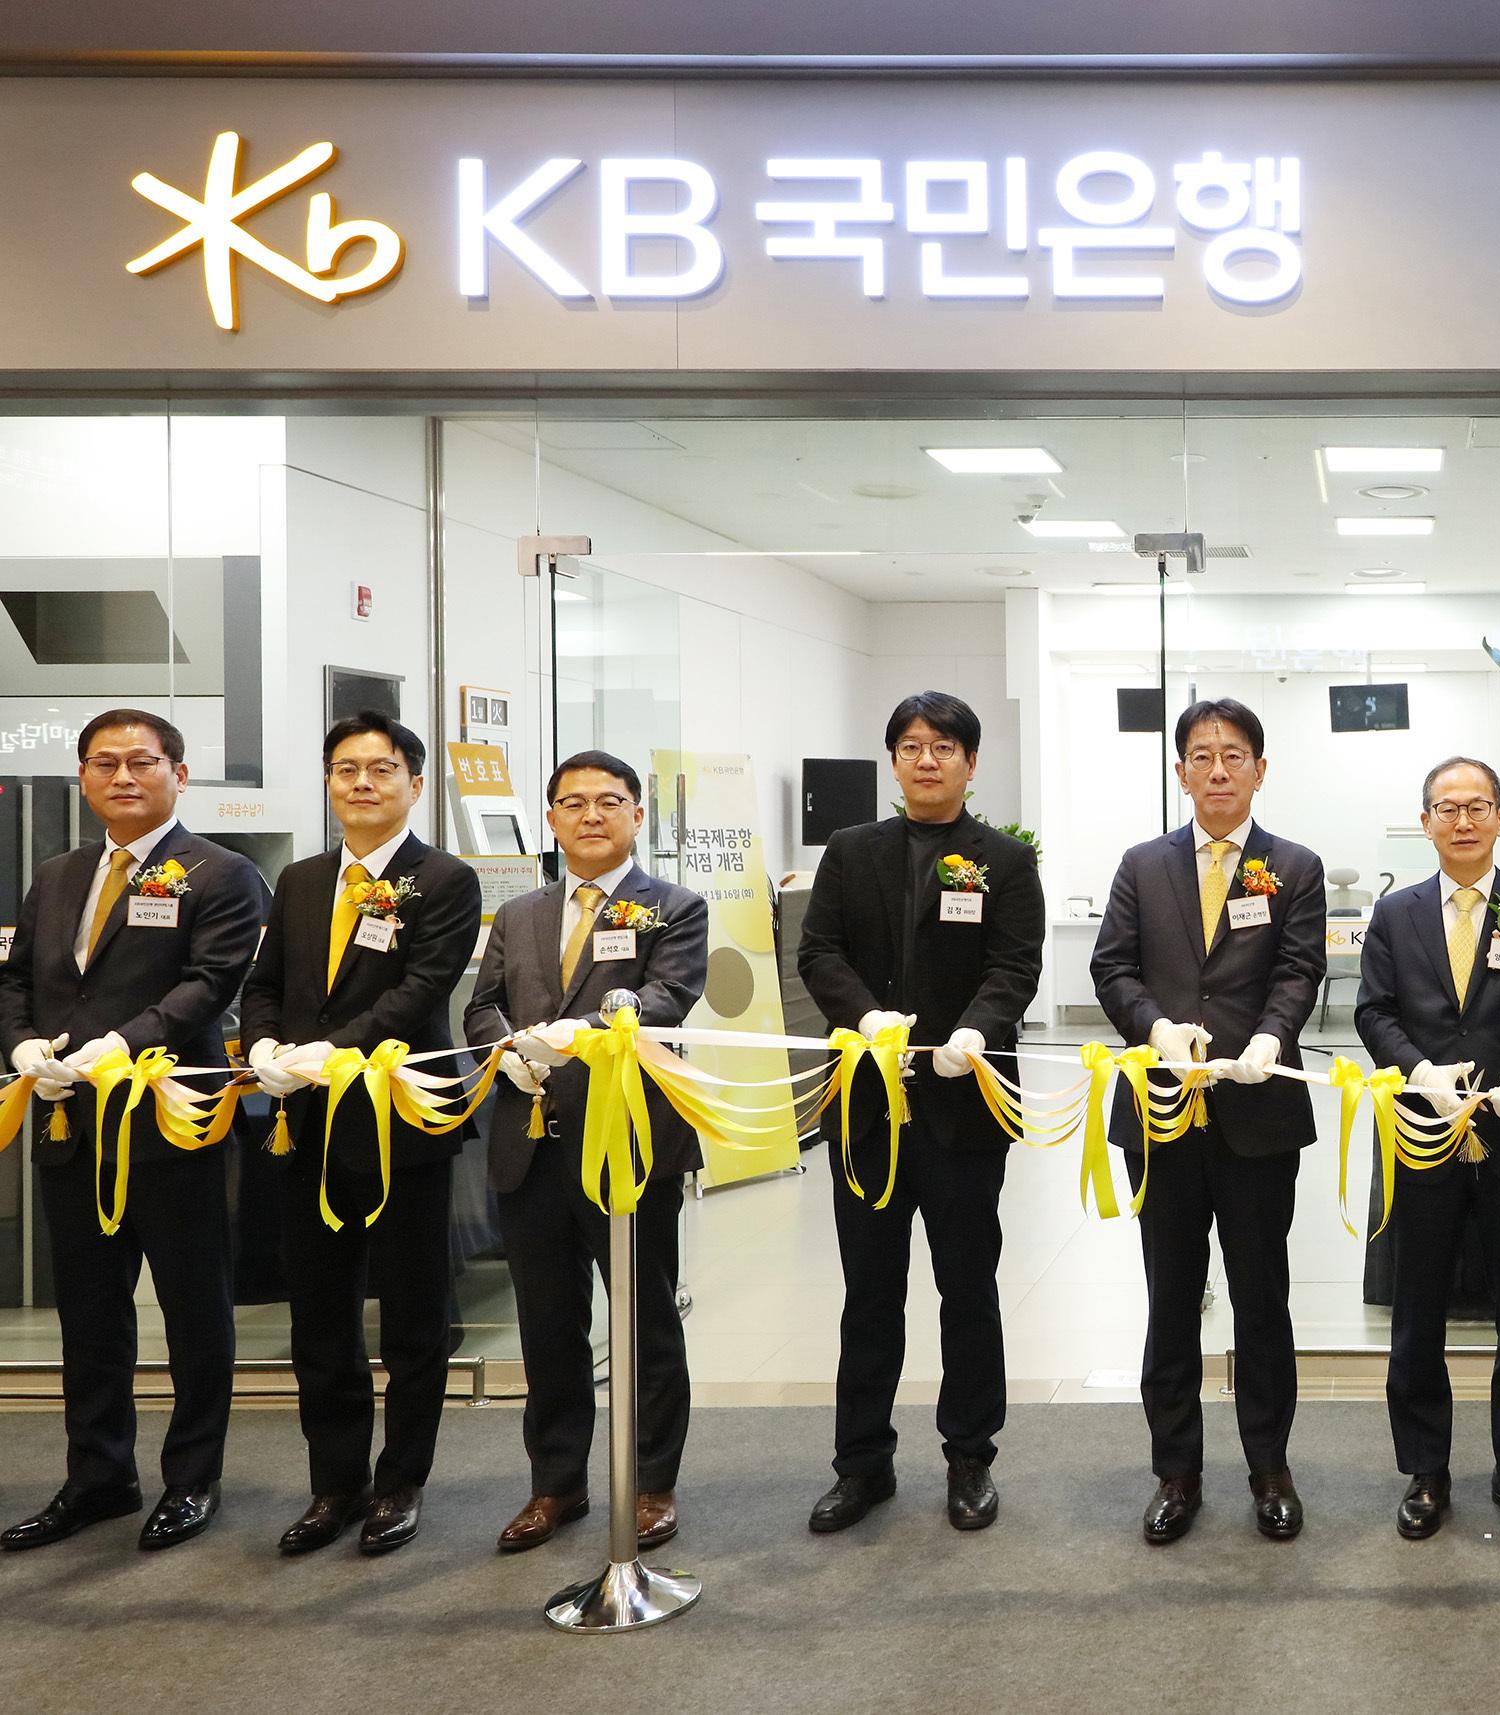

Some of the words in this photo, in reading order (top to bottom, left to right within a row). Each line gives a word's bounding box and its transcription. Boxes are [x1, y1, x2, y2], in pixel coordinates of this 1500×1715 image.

[458, 157, 726, 298] KB
[755, 150, 1302, 304] 국민은행
[458, 757, 505, 783] 번호표
[217, 802, 265, 817] 공과금수납기
[686, 852, 713, 873] 지점
[717, 852, 745, 873] 개점
